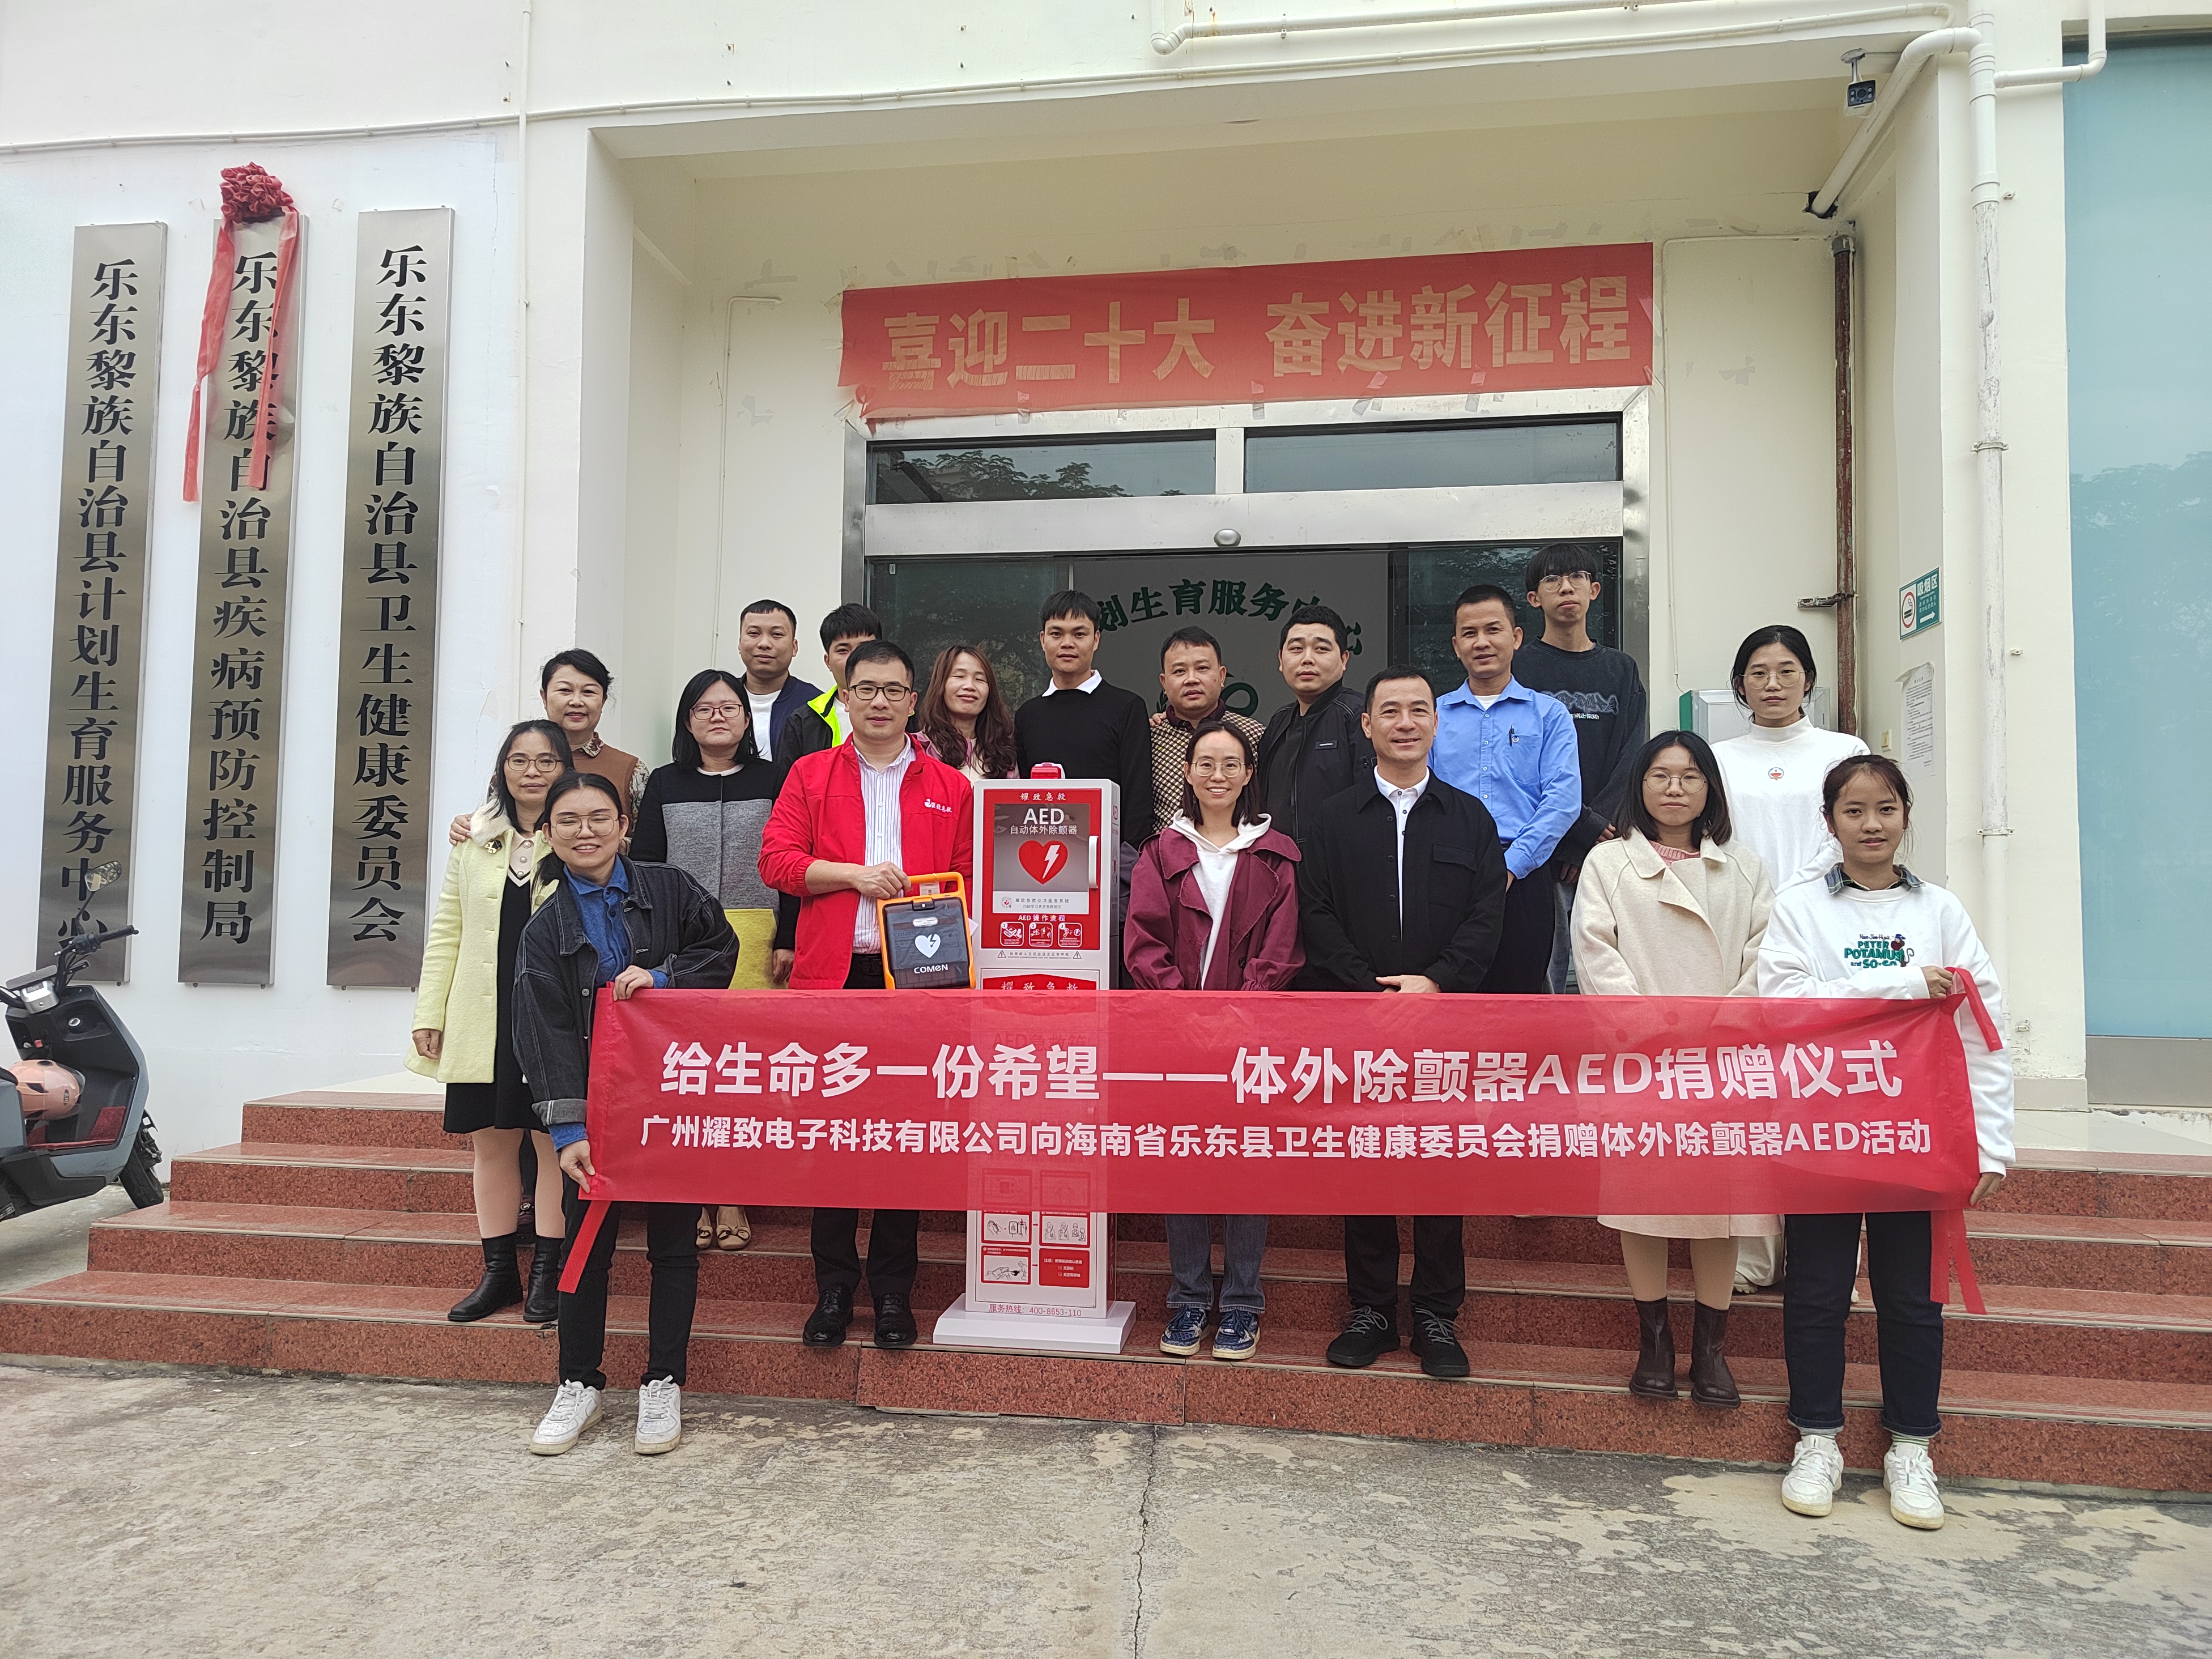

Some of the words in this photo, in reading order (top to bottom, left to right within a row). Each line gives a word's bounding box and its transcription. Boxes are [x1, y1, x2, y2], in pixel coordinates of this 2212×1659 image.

[882, 296, 1216, 390] 喜迎二十大
[1265, 275, 1630, 377] 奋进新征程
[199, 251, 278, 945] 乐东黎族自治县疾病预防控制局
[348, 244, 427, 942] 乐东黎族自治县卫生健康委员会
[1917, 573, 1937, 597] 吸烟区
[1098, 578, 1362, 656] 划生育服务
[1010, 825, 1078, 835] 自动体外除颤器
[1023, 808, 1064, 825] AED
[1844, 947, 1903, 962] POTAMUS
[1857, 941, 1889, 949] PETER
[640, 1114, 1930, 1159] 广州耀致电子科技有限公司向海南省乐东县卫生健康委员会捐赠体外除颤器AED活动
